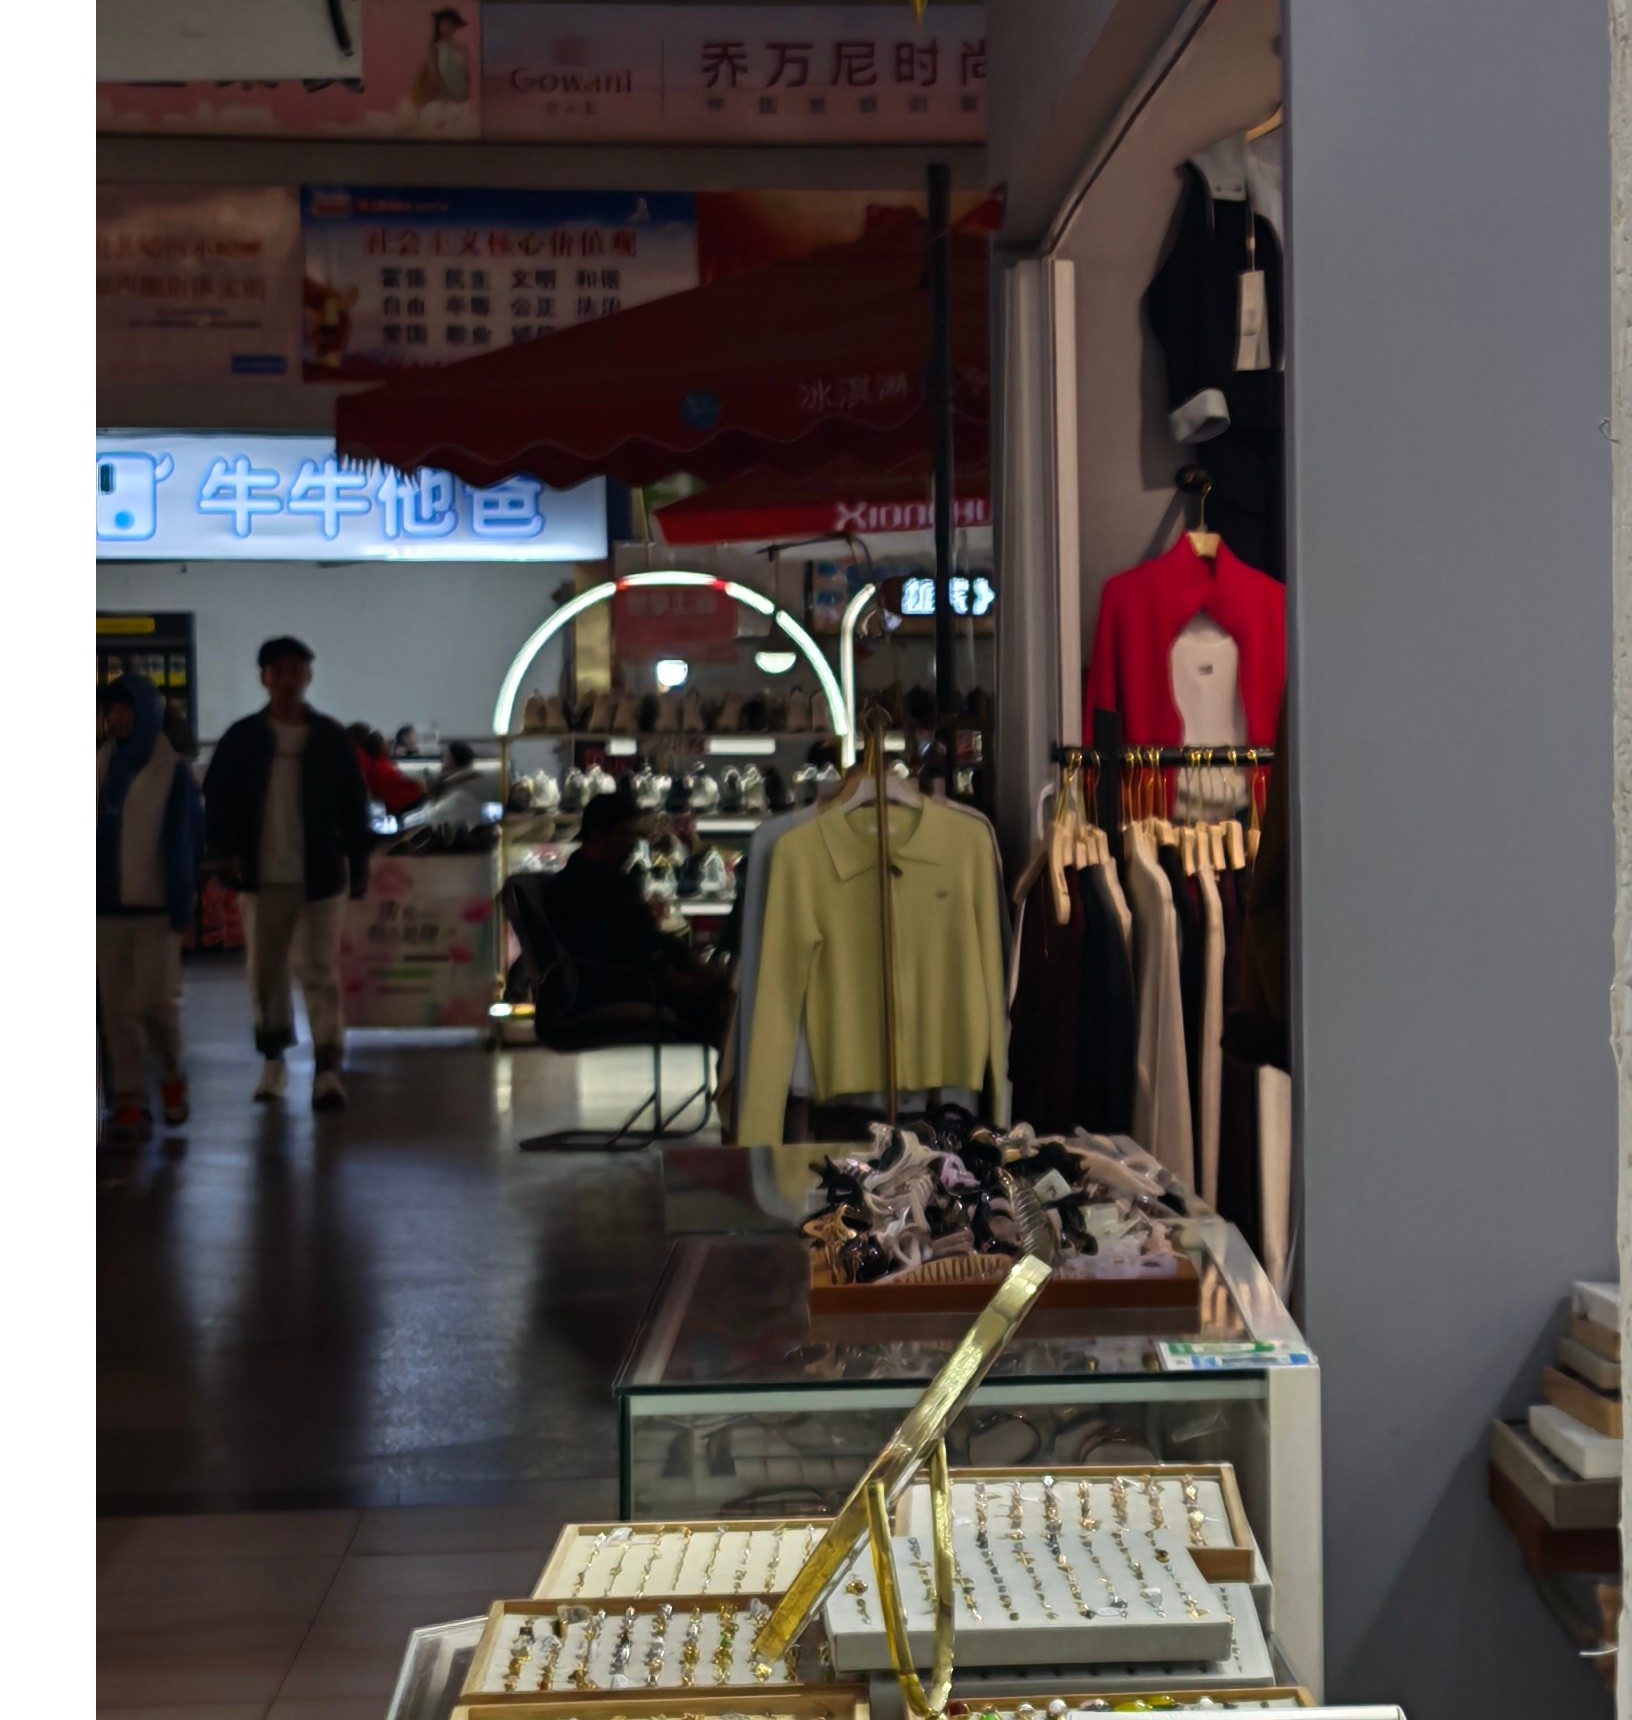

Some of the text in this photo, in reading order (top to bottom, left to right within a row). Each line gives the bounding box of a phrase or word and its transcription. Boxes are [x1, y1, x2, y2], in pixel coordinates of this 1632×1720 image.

[363, 227, 637, 257] 社会主义核心价值观
